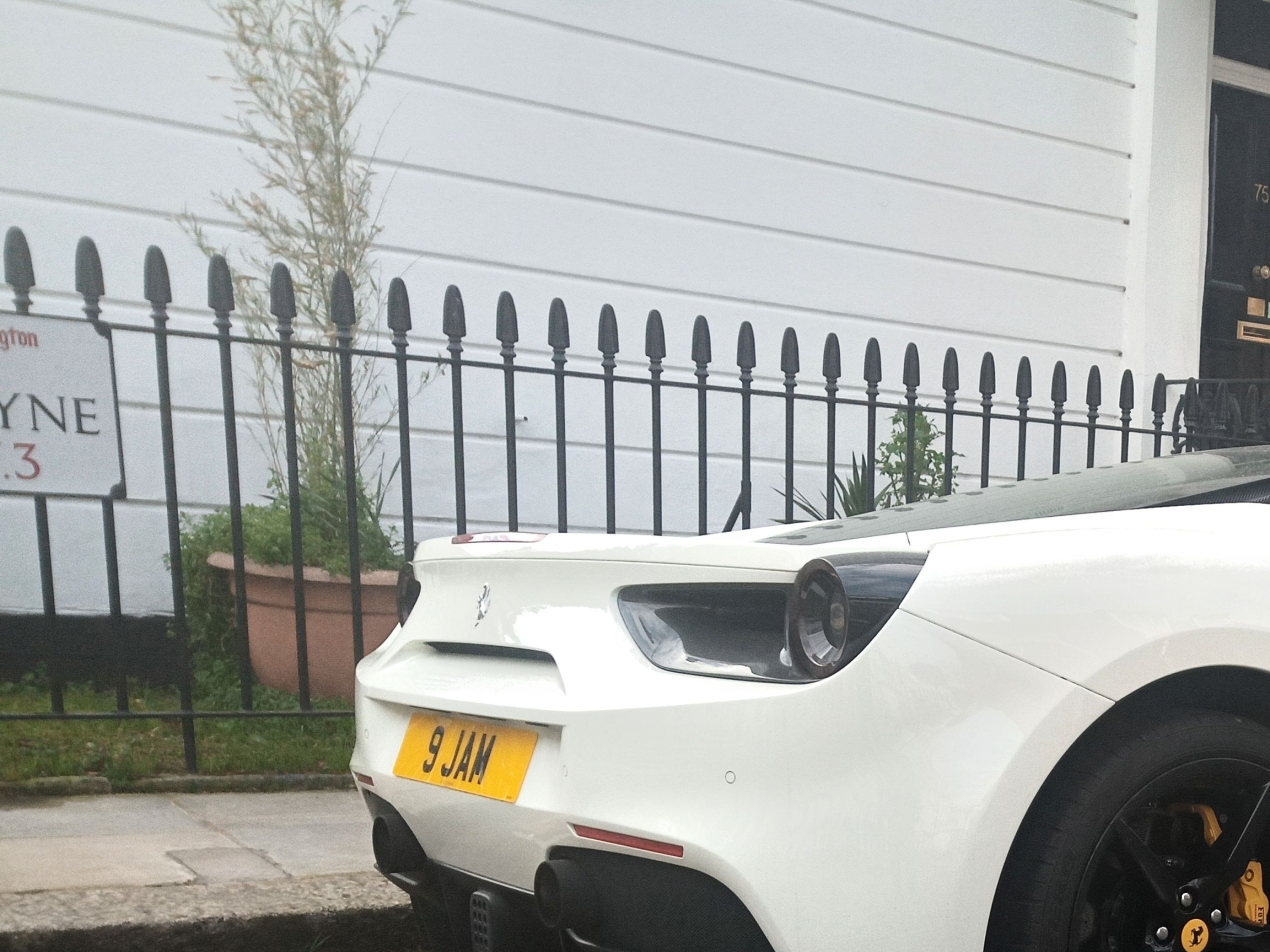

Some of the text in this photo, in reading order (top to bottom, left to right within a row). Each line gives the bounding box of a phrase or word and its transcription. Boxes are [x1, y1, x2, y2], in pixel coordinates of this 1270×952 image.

[1254, 183, 1270, 204] 75
[422, 726, 497, 785] 9 JAM
